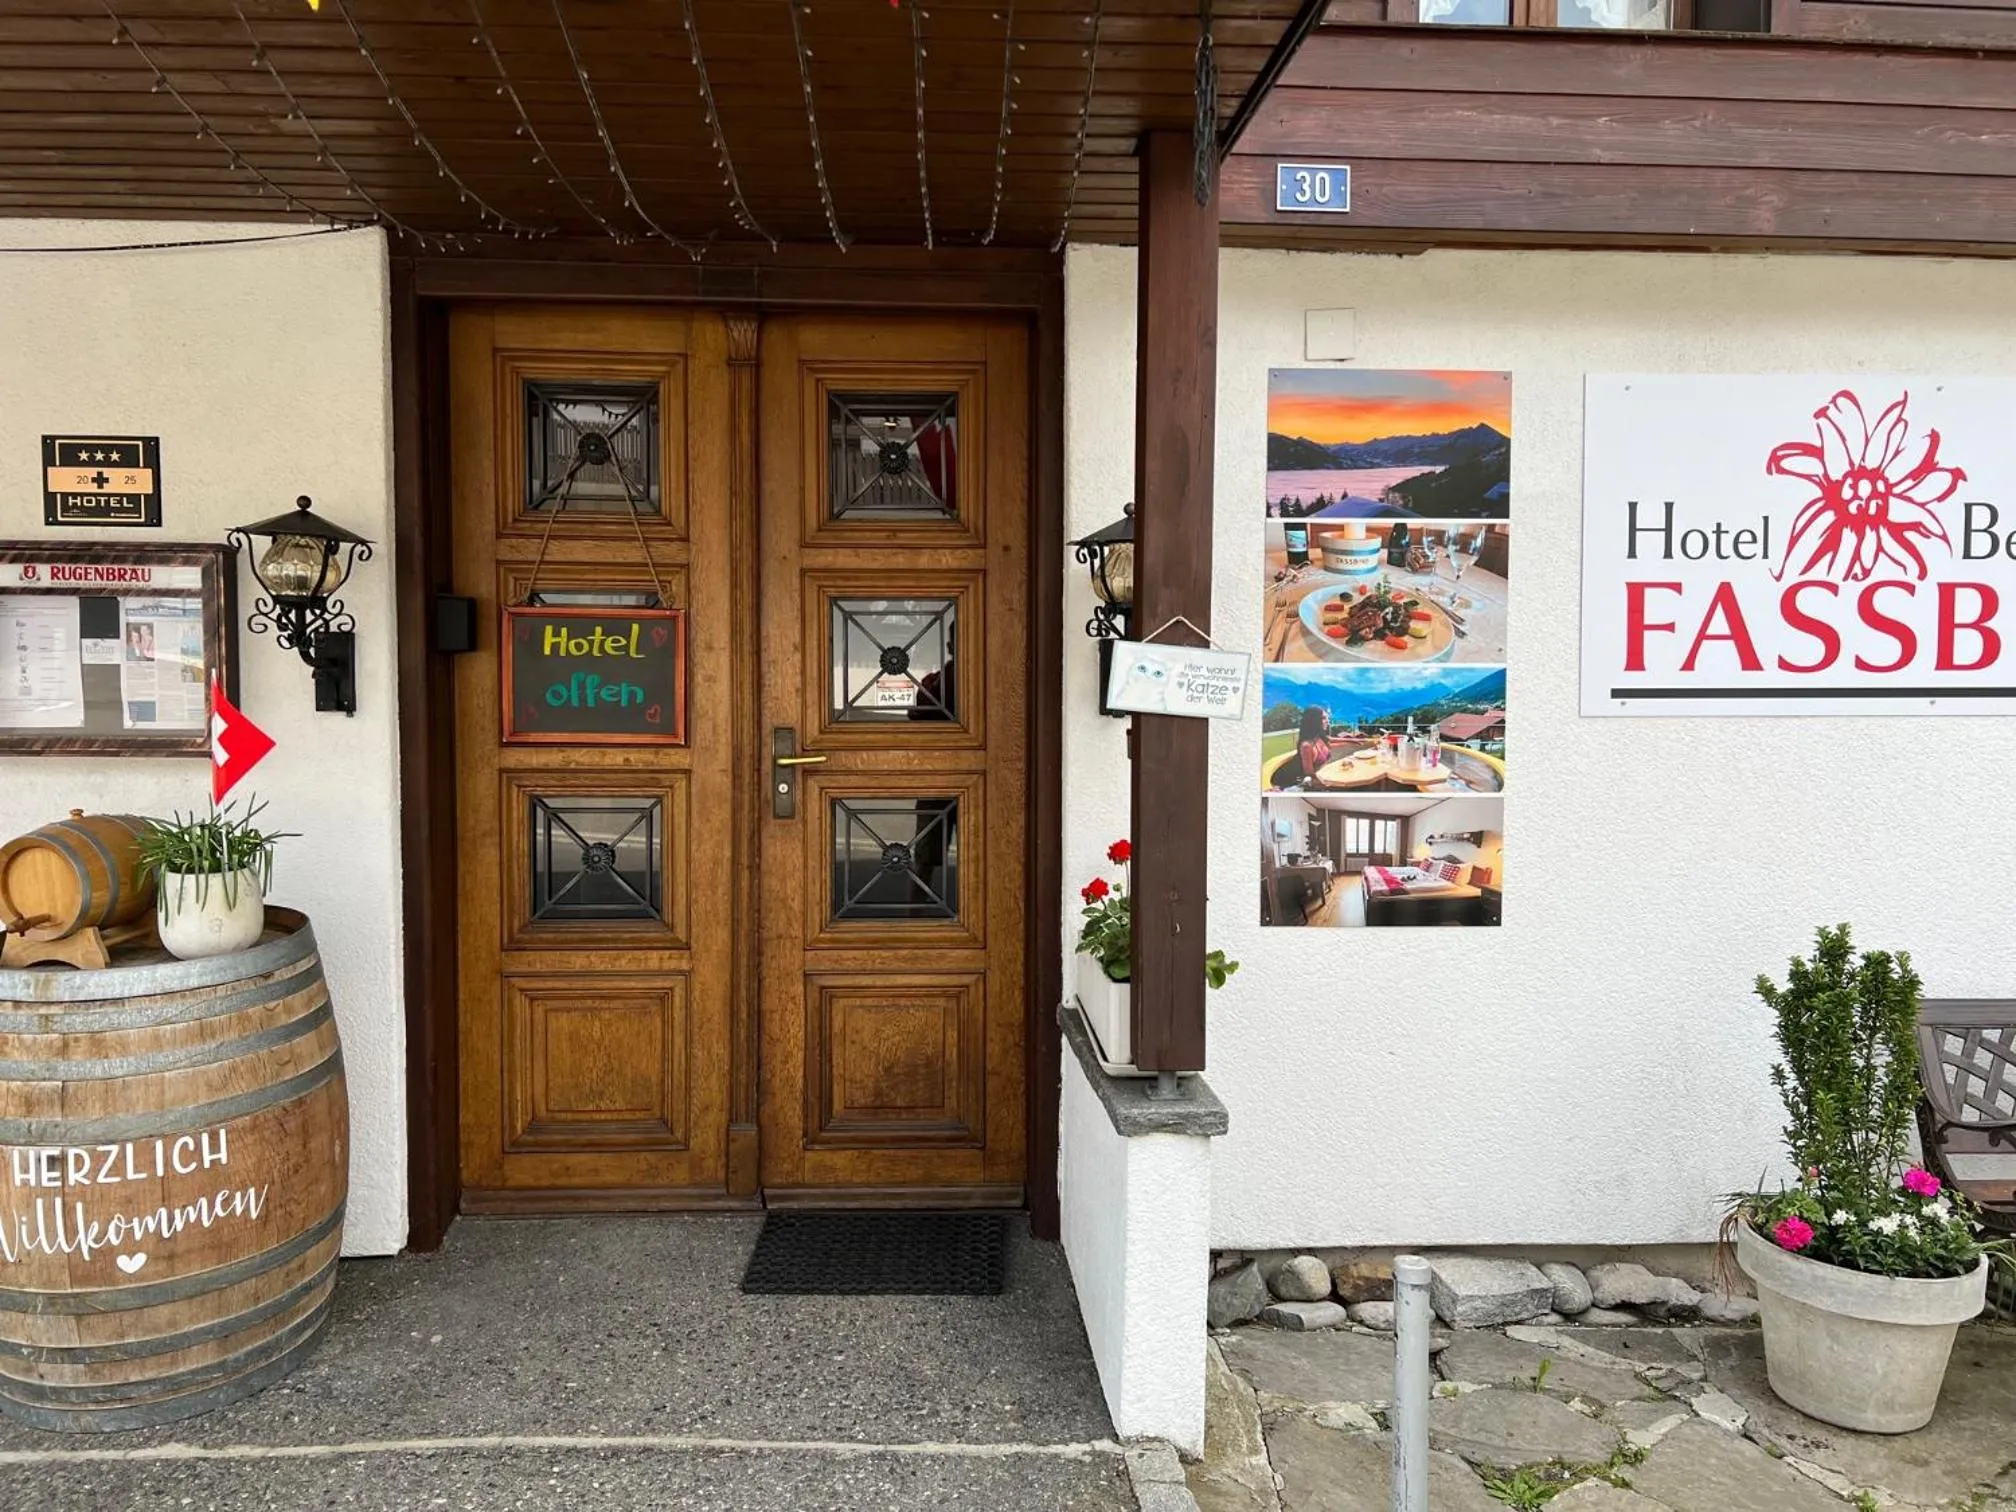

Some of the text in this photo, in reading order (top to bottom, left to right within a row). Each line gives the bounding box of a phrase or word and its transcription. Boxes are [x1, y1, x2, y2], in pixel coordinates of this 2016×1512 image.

[1295, 171, 1330, 203] 30
[76, 475, 137, 485] 20 25
[67, 495, 134, 508] HOTEL
[1626, 501, 1769, 560] Hotel
[50, 565, 152, 582] RUGENBRÄU
[543, 623, 645, 658] Hotel
[1623, 580, 2002, 674] FASSB
[545, 671, 645, 707] offen
[1186, 679, 1229, 696] Katze
[13, 1128, 228, 1187] HERZLICH
